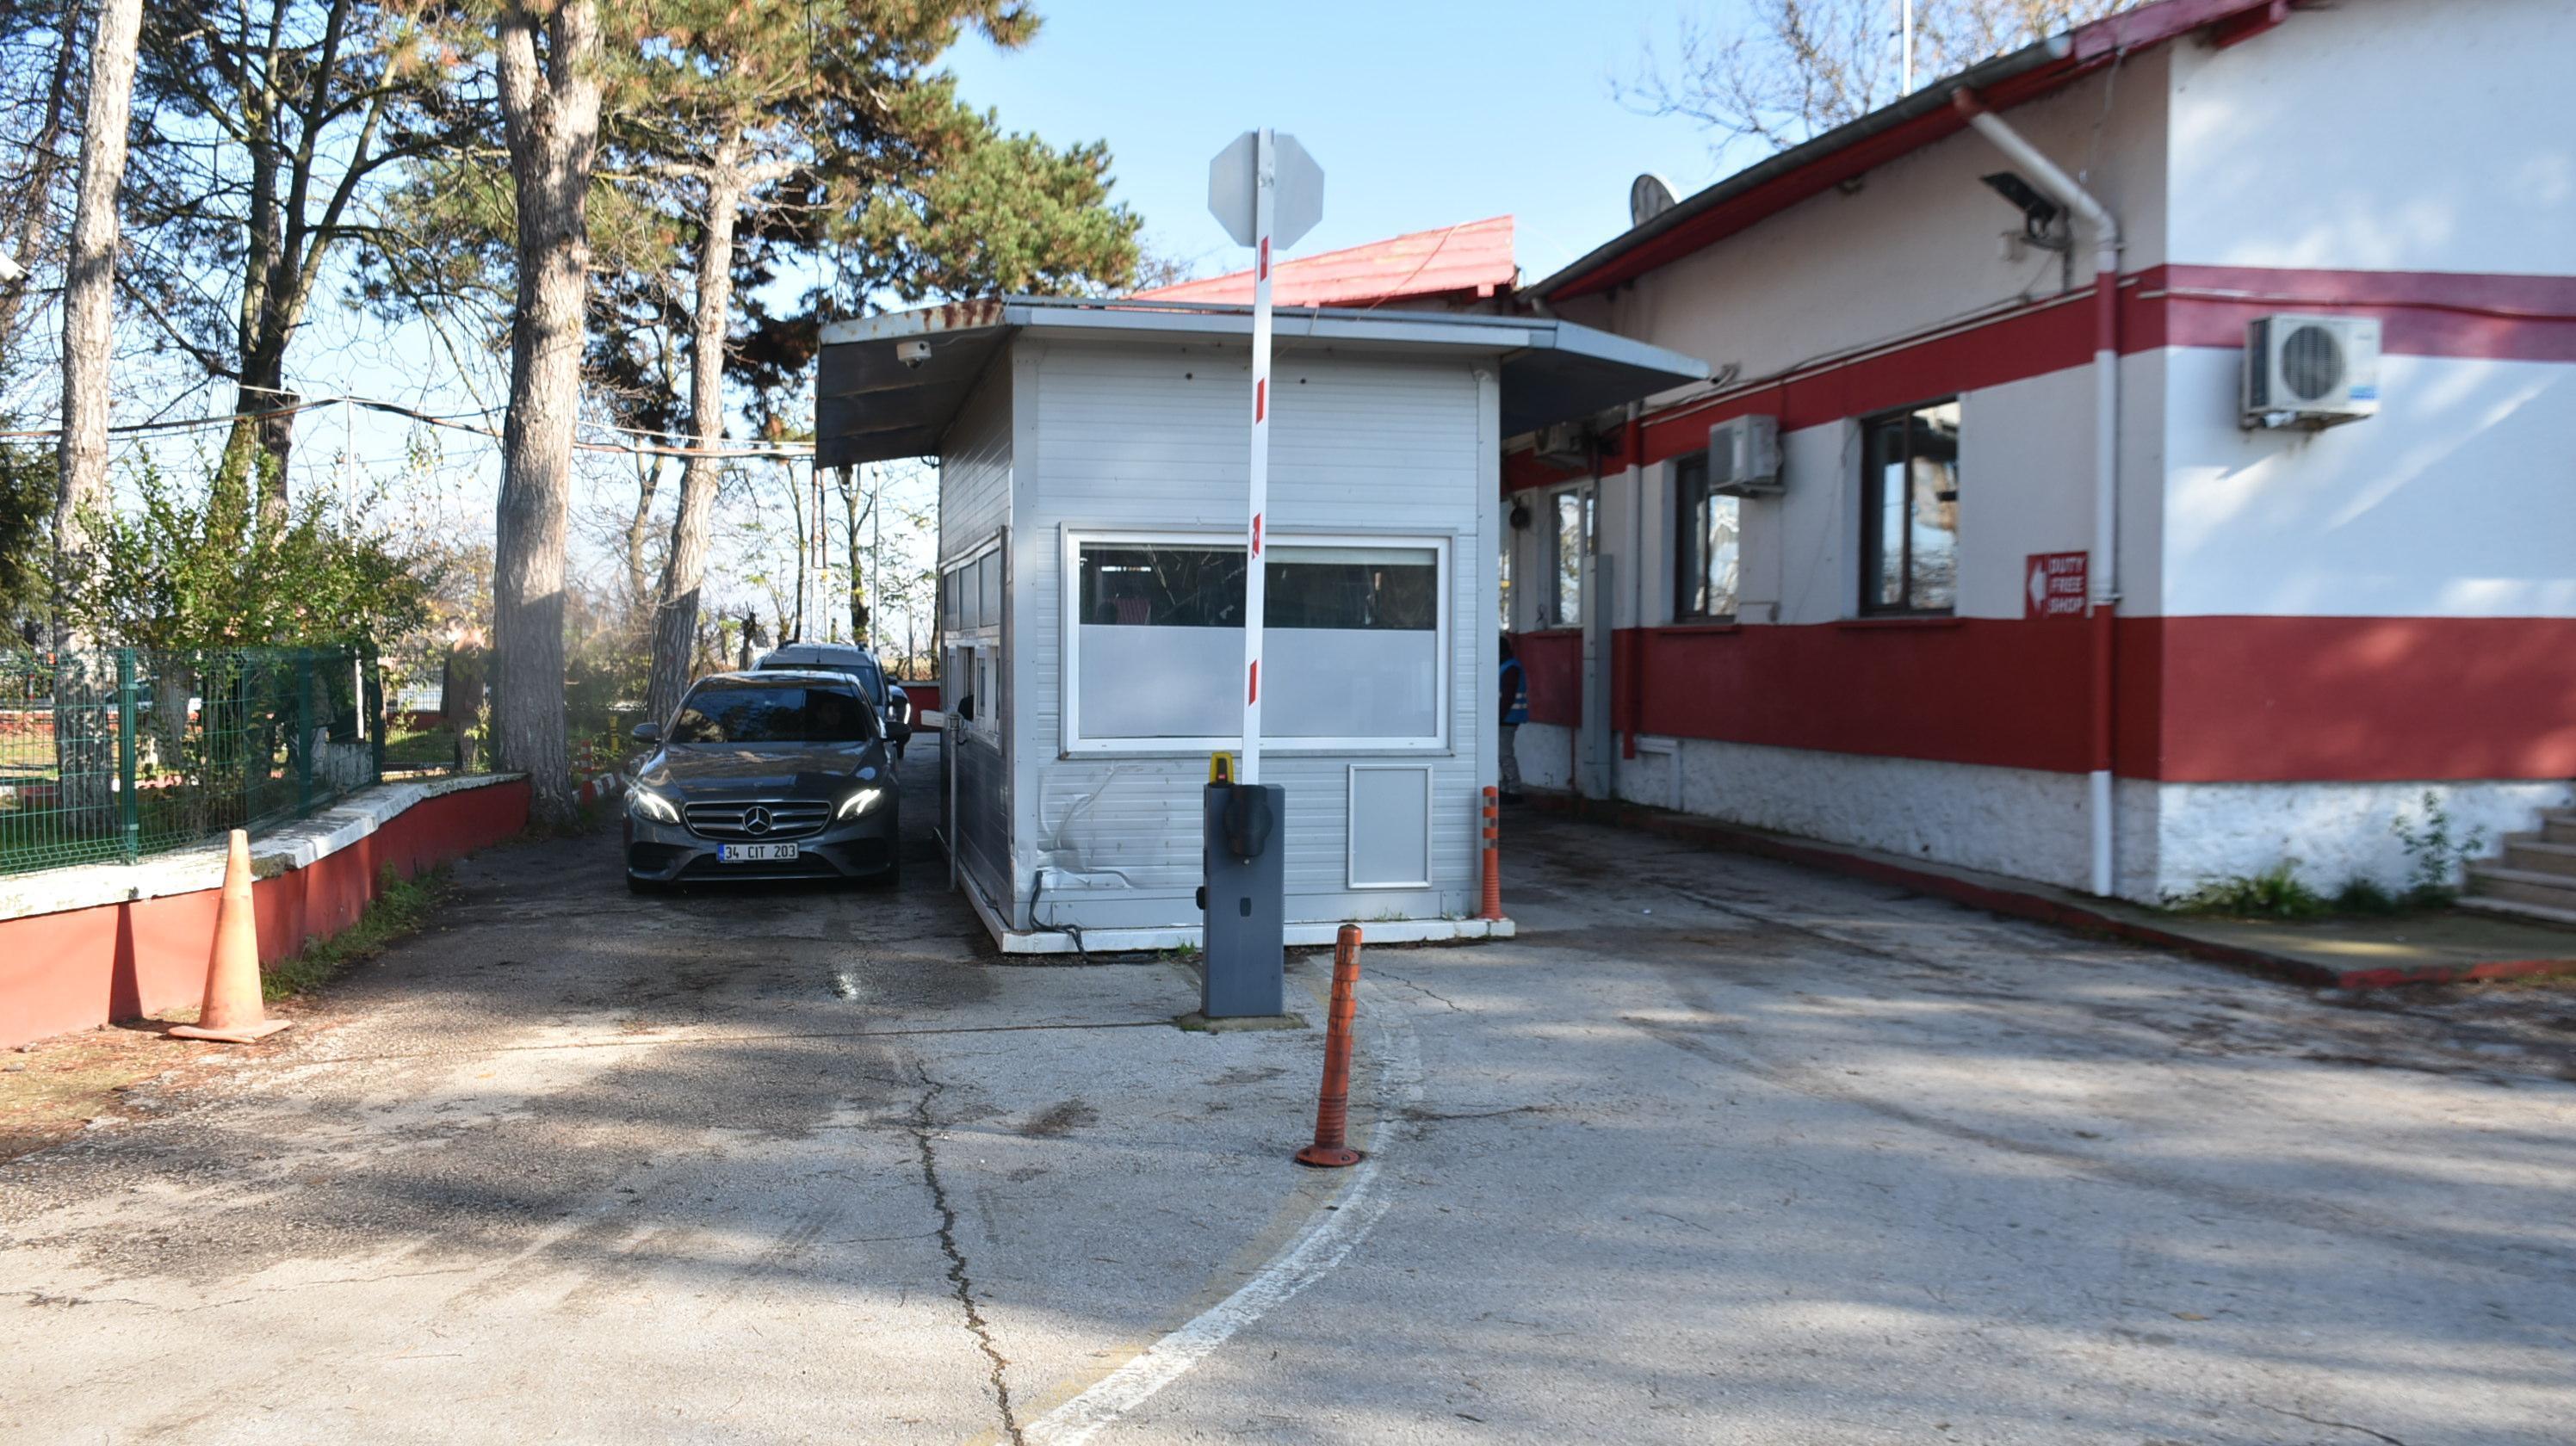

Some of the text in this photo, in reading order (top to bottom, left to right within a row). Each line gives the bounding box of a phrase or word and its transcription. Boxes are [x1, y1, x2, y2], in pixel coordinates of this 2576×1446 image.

[2049, 557, 2084, 574] DUTY
[2050, 576, 2084, 594] FREE
[2049, 596, 2085, 615] SHOP
[726, 845, 796, 859] 34 CIT 203
